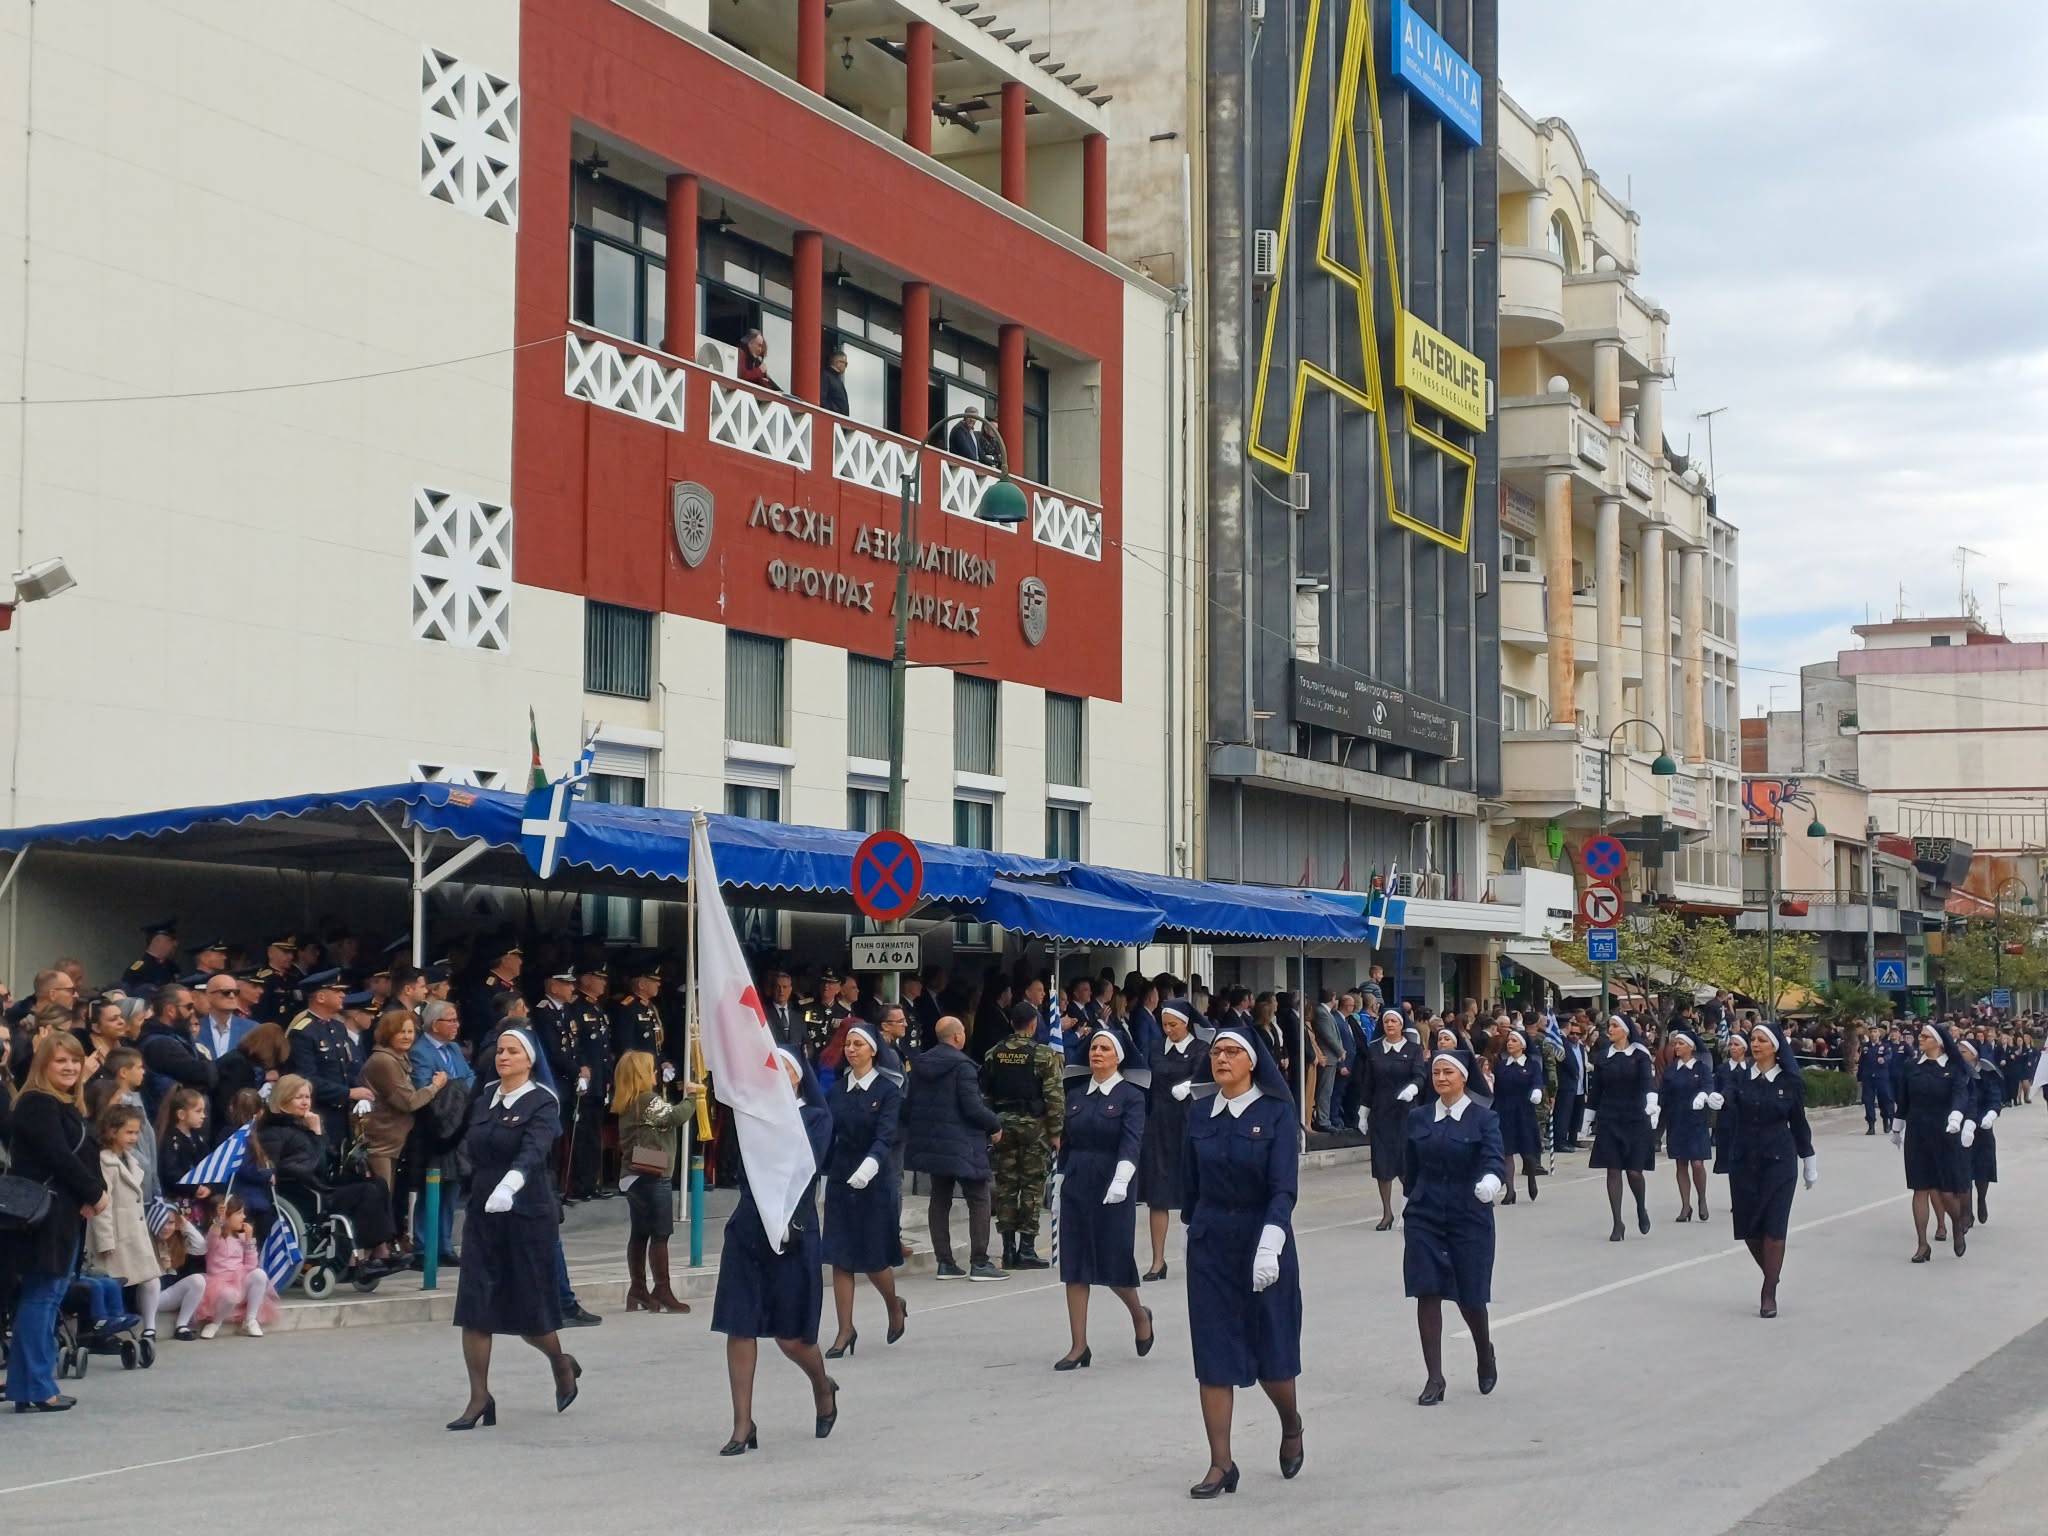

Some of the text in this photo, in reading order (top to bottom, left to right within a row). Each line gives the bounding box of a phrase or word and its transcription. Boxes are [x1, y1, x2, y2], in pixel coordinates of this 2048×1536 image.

[1404, 16, 1479, 112] ALIAVITA
[1411, 328, 1480, 399] ALTERLIFE
[1411, 367, 1480, 417] FITNESS EXCELLENCE
[748, 495, 835, 547] ΛΕΣΧΗ
[767, 558, 875, 613] ΦΡΟΥΡΑΣ
[997, 1052, 1030, 1060] MILITARY
